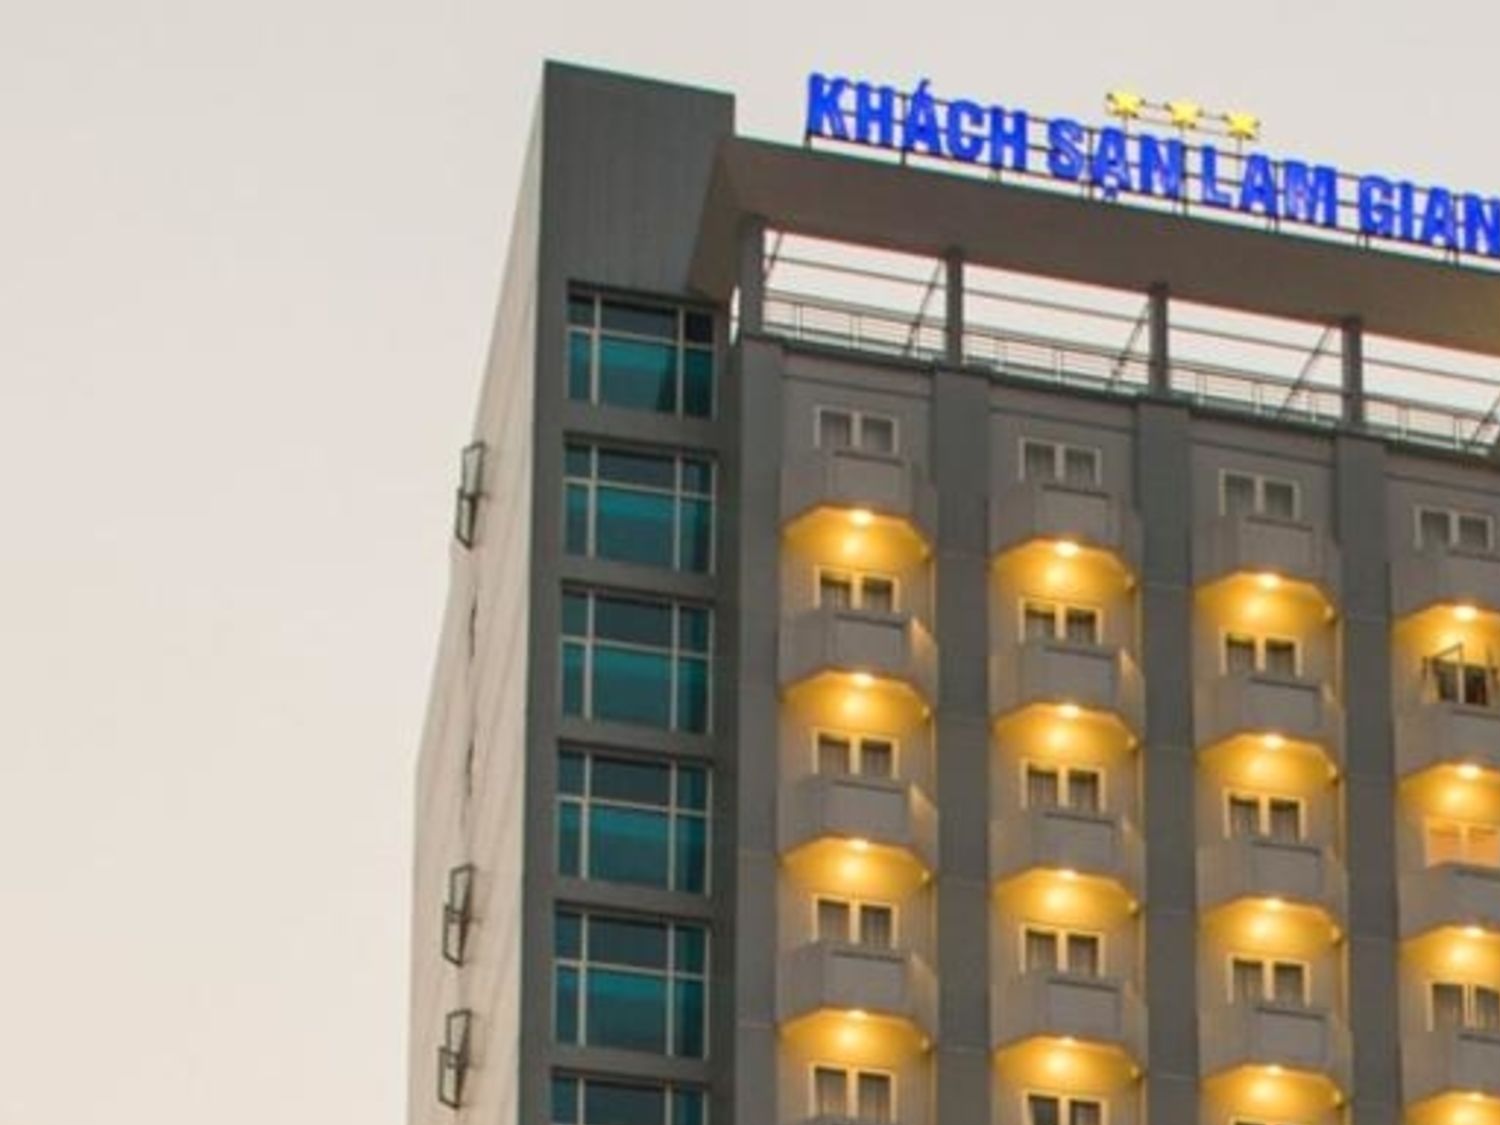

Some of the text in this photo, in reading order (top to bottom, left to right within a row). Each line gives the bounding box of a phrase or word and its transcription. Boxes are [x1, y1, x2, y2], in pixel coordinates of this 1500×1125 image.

[806, 72, 1029, 171] KHÁCH
[1045, 116, 1184, 201] SẠN
[1199, 144, 1339, 228] LAM
